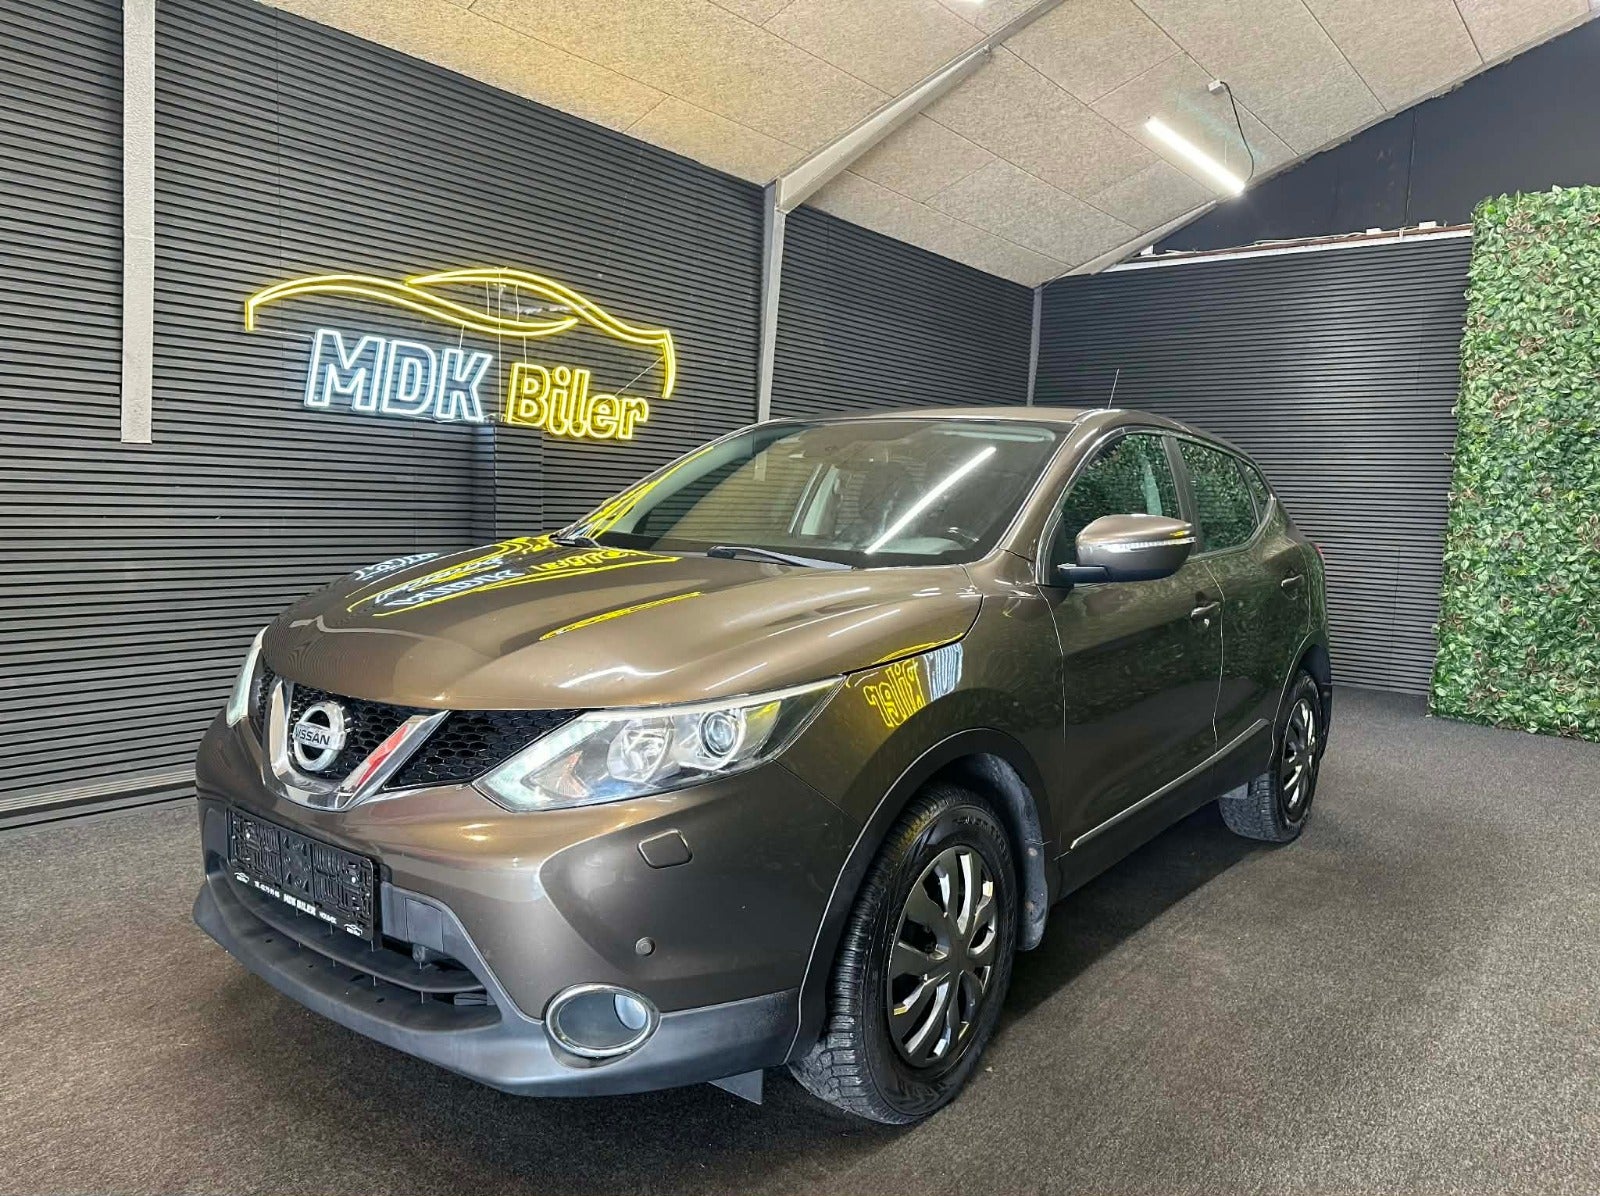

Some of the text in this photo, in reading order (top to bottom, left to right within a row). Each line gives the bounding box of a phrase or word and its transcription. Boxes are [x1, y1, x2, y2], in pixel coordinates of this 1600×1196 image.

[305, 328, 649, 440] MDK Biler
[295, 727, 330, 745] NISSAN
